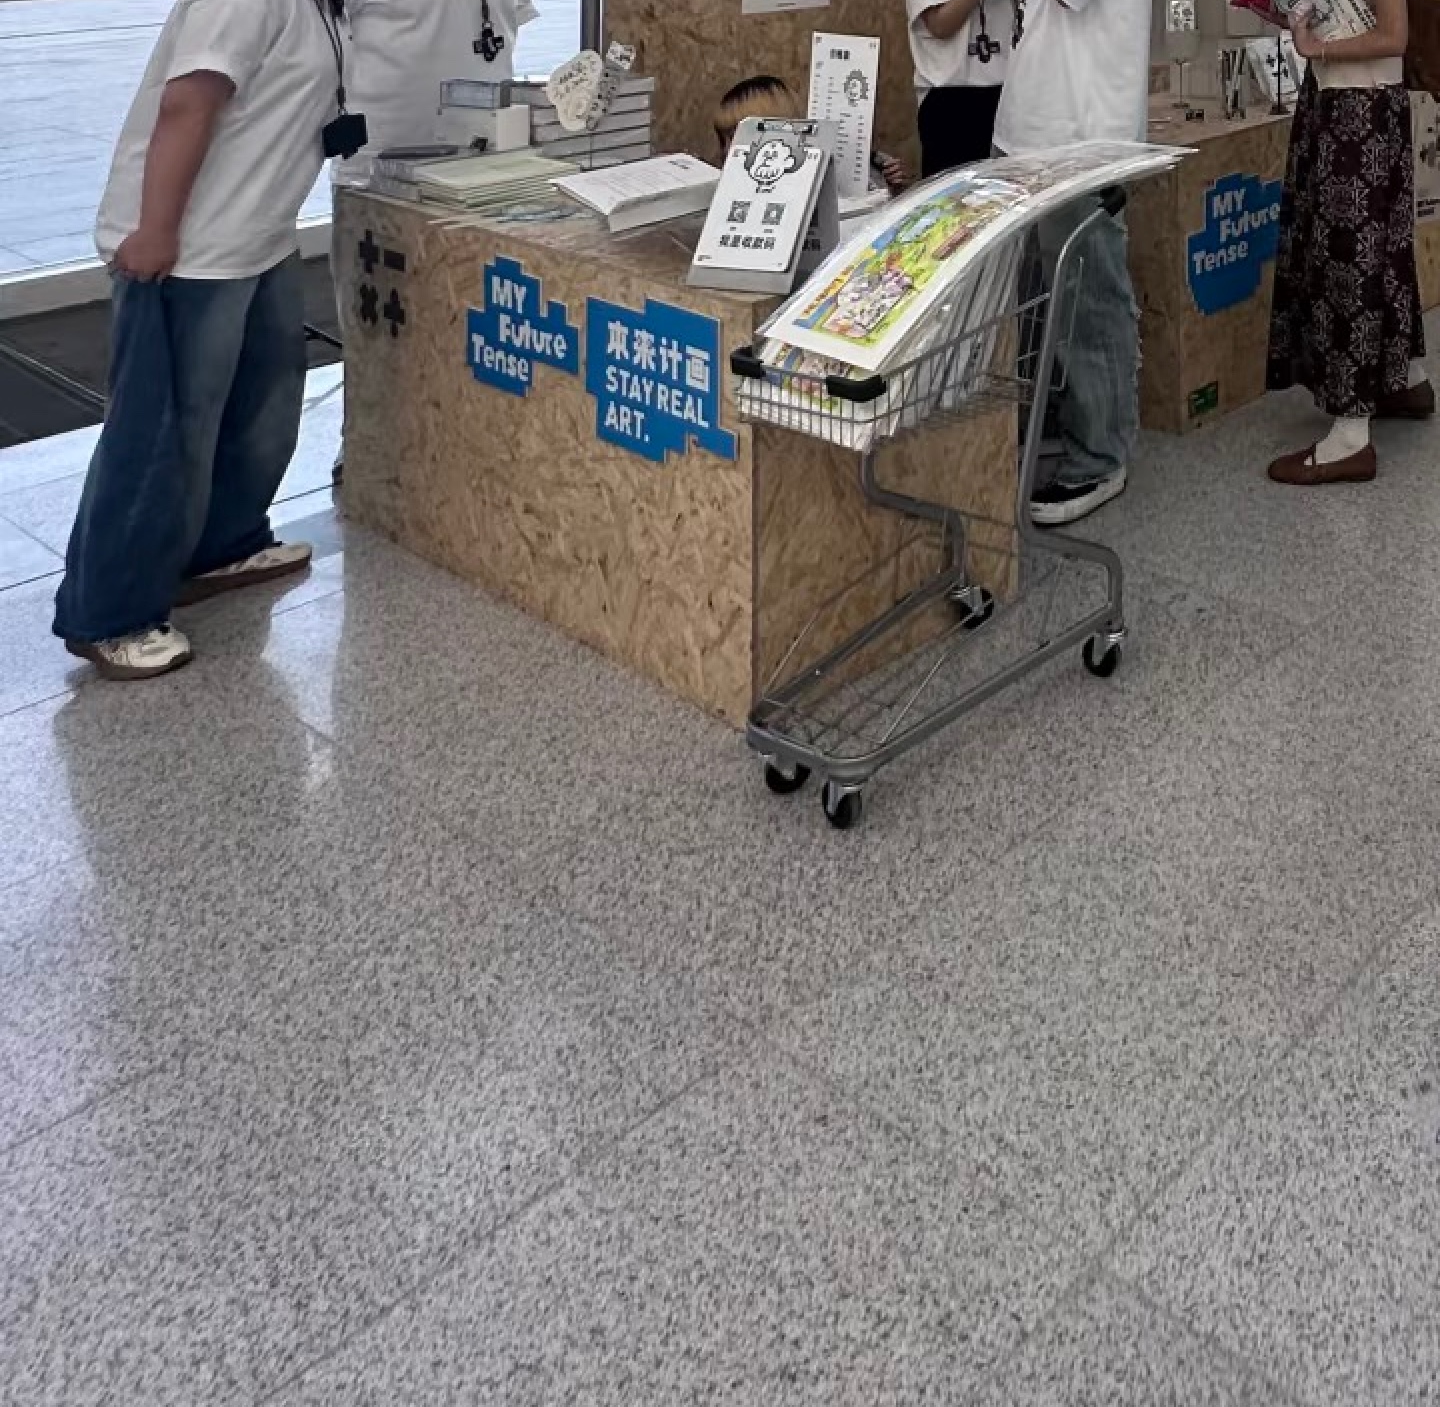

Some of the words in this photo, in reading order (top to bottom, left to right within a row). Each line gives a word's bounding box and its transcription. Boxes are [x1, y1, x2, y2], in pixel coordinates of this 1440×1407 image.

[1213, 187, 1246, 219] MY
[1219, 202, 1281, 243] Future
[1193, 240, 1248, 275] Tense
[491, 275, 527, 313] MY
[499, 313, 567, 359] Future
[472, 333, 528, 382] Tense
[604, 400, 650, 442] ART.
